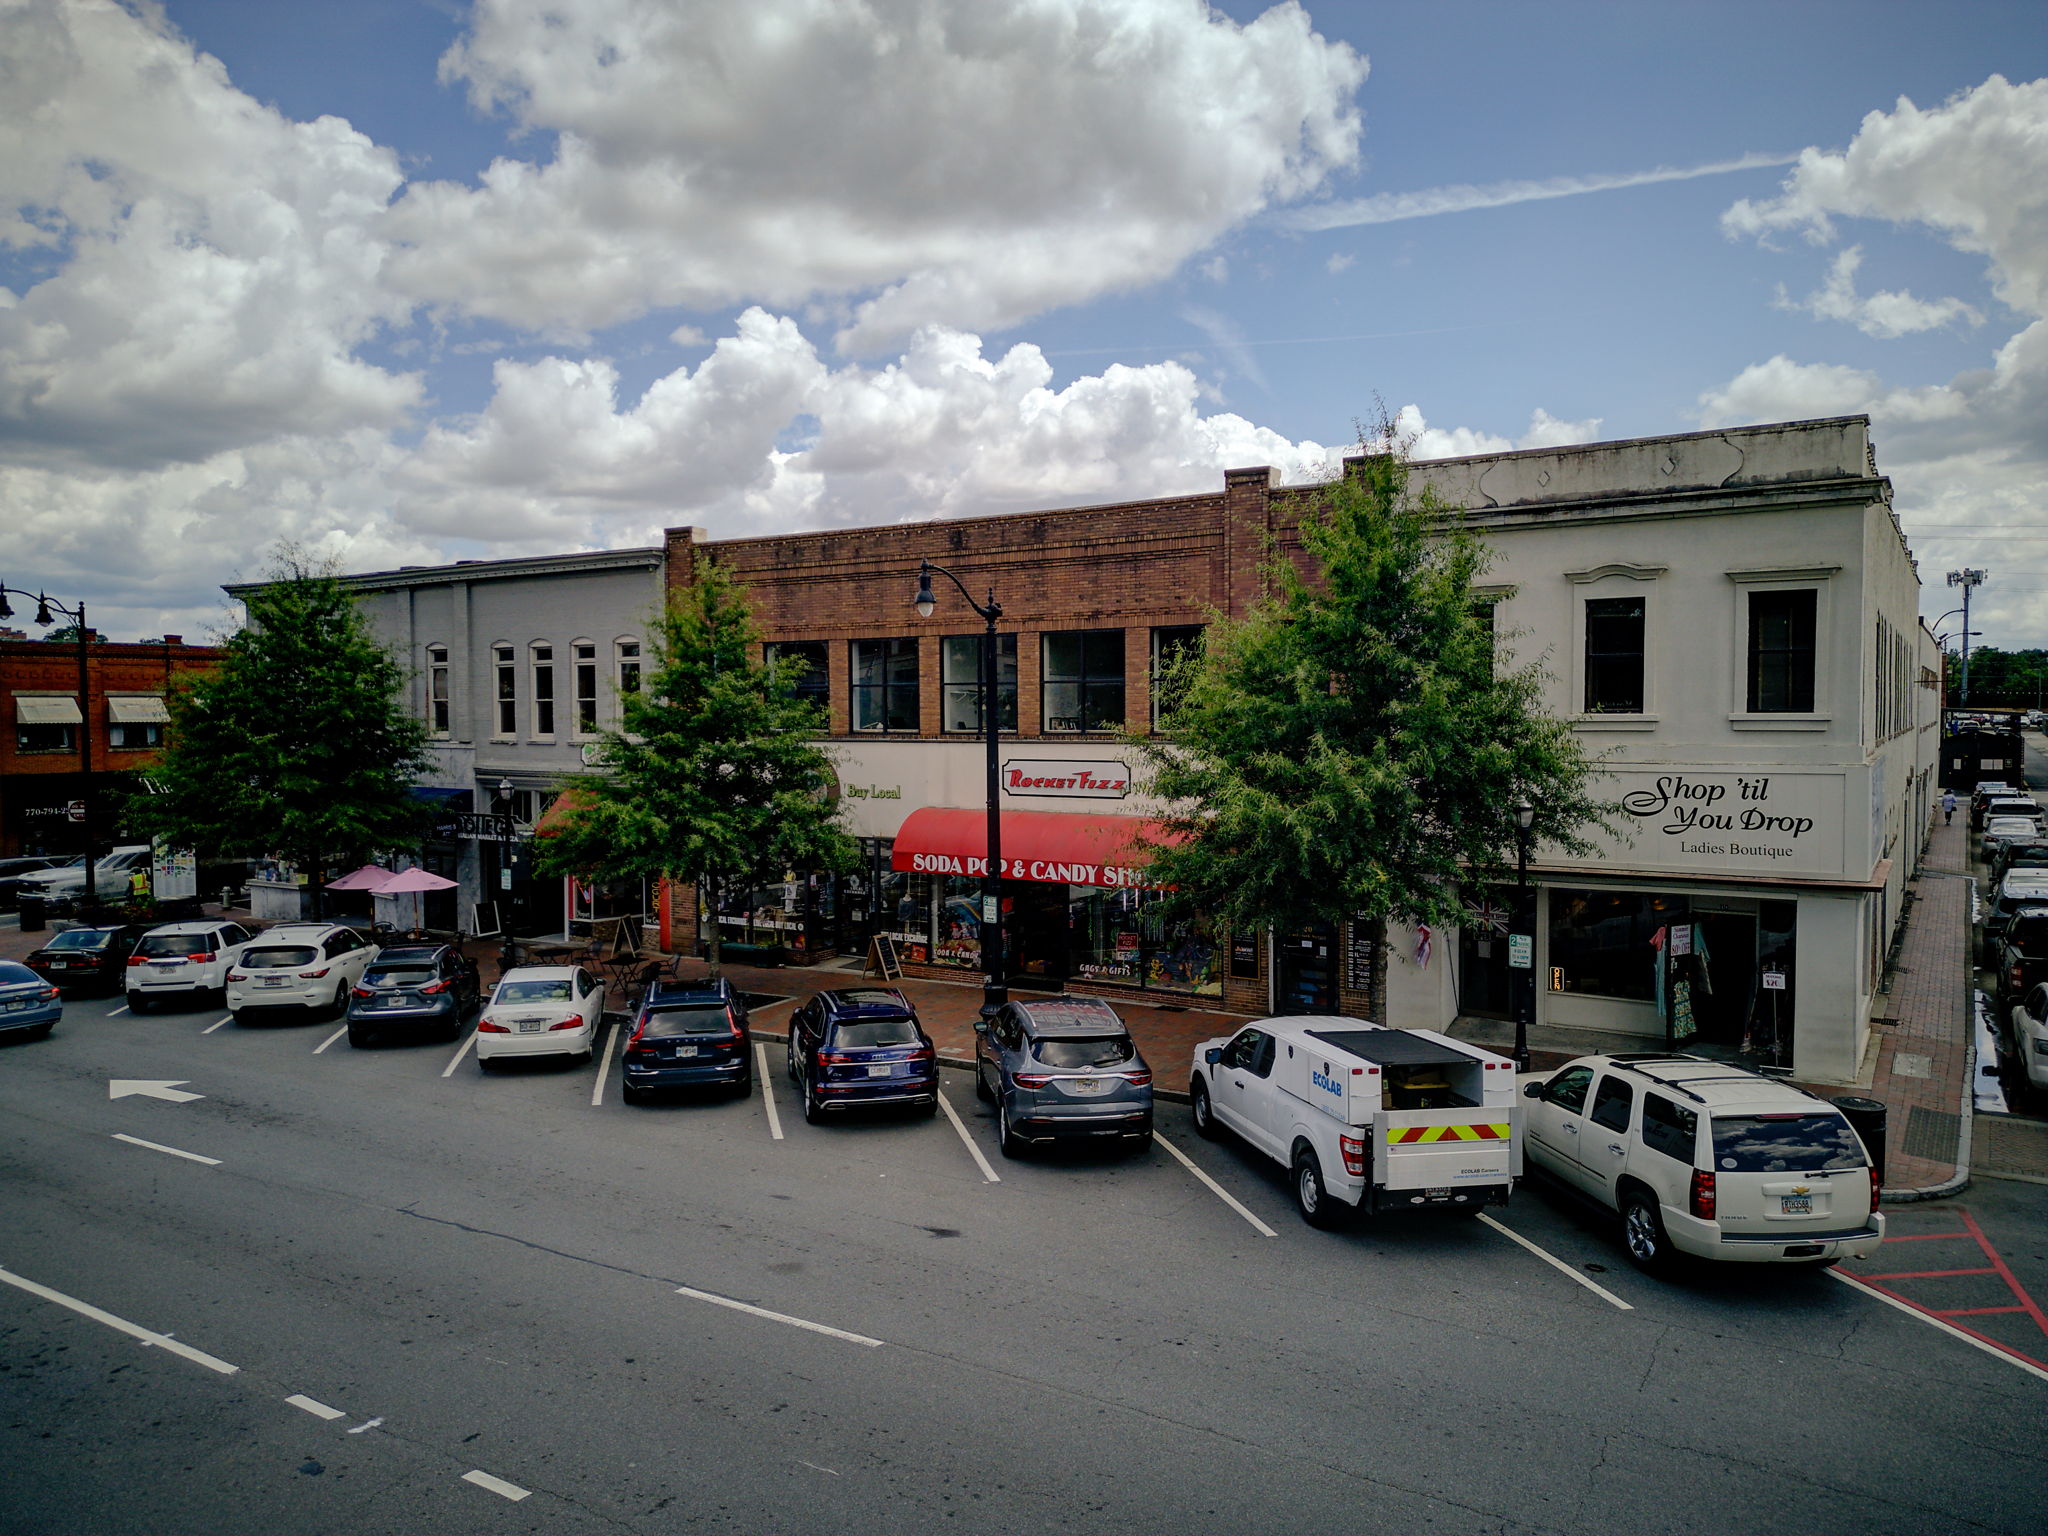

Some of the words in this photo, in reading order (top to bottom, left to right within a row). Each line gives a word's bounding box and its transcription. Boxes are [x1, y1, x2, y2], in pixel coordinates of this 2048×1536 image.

[847, 784, 869, 801] Buy
[871, 784, 901, 799] Local
[1623, 776, 1727, 816] Shop
[1737, 777, 1770, 801] 'til
[1662, 806, 1735, 834] You
[1741, 807, 1815, 838] Drop
[1681, 841, 1725, 854] Ladies
[1730, 844, 1793, 859] Boutique
[912, 852, 963, 874] SODA
[1012, 859, 1026, 878] &
[1031, 860, 1099, 884] CANDY
[1079, 963, 1101, 973] GAGS
[1109, 966, 1132, 976] GIFTS
[1554, 967, 1562, 991] OPEN
[1312, 1070, 1342, 1098] ECOLAB
